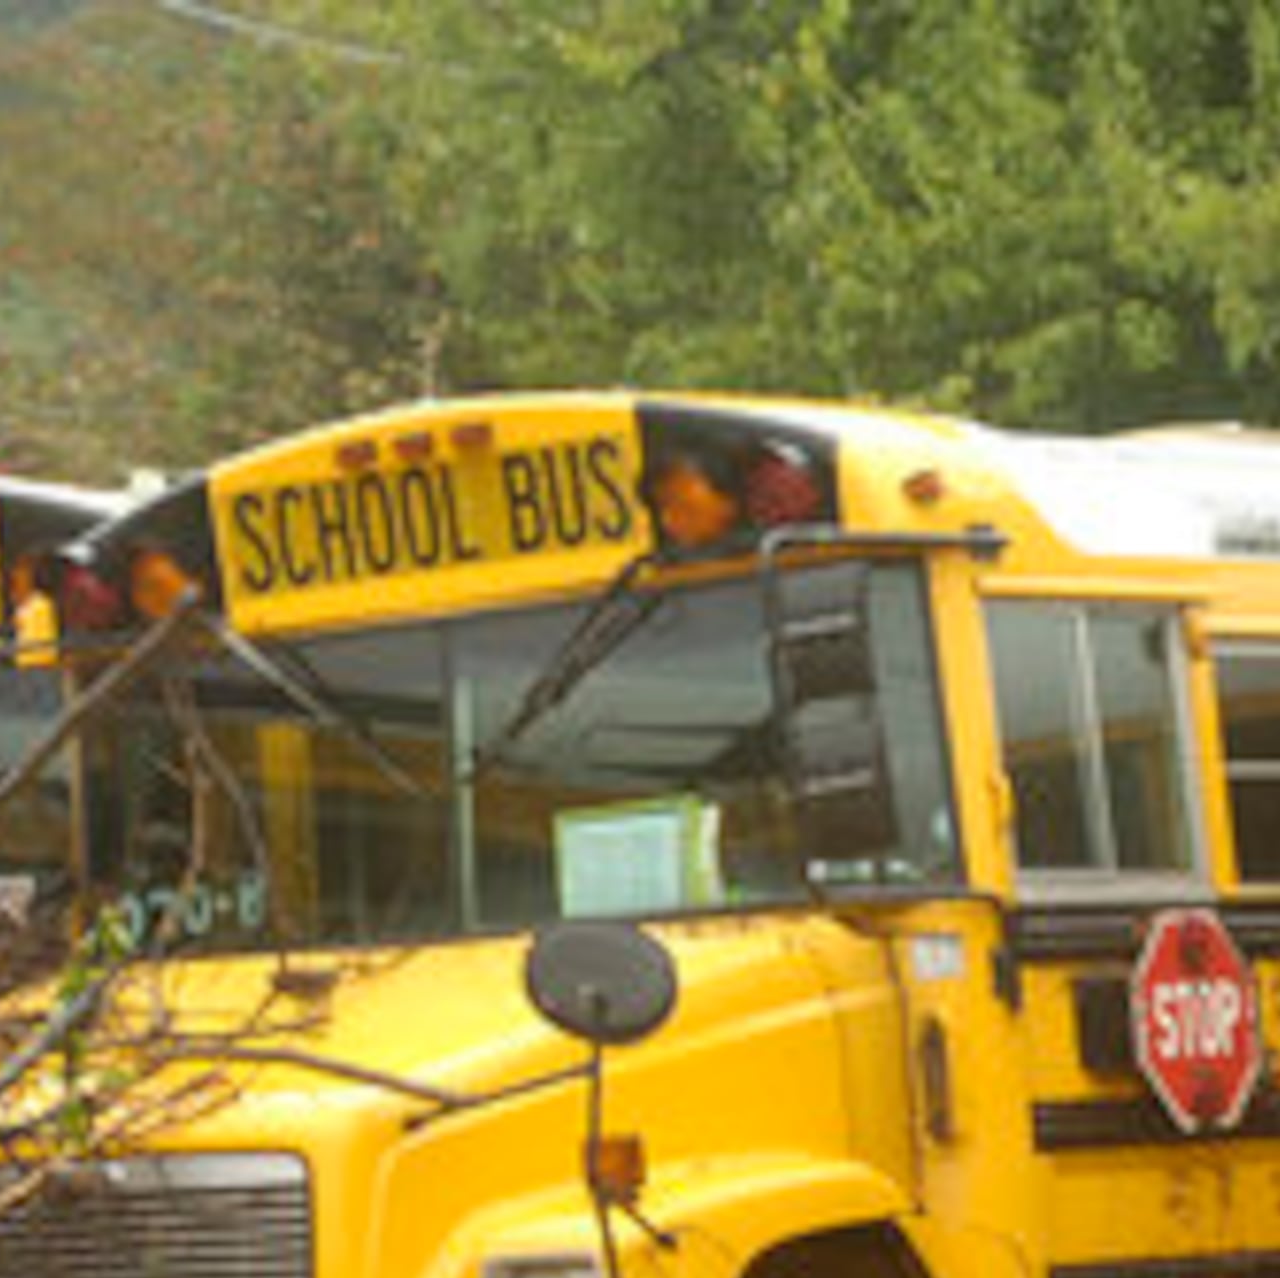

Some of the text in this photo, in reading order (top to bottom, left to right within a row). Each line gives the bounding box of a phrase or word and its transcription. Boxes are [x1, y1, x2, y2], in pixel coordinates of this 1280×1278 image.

[233, 437, 632, 592] SCHOOL BUS
[1151, 977, 1242, 1060] STOP
